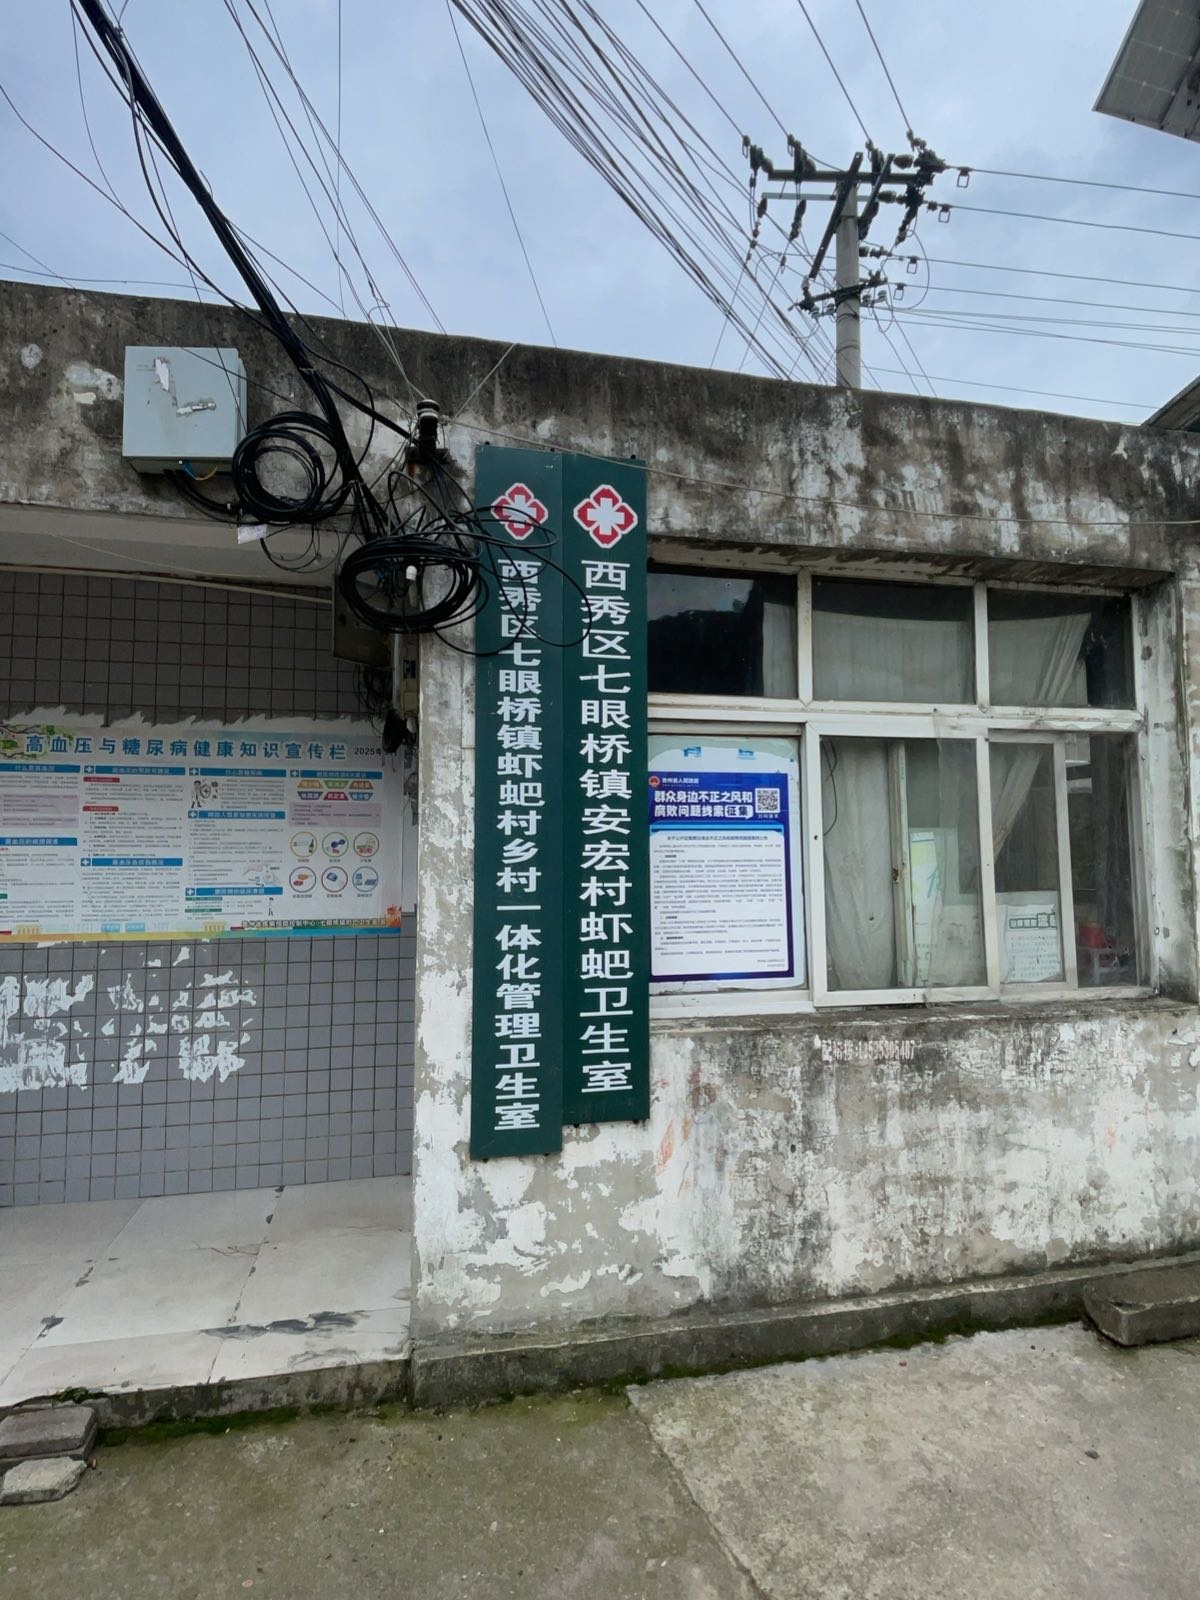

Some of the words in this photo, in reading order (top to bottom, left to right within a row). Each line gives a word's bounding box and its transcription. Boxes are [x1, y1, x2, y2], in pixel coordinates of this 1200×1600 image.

[26, 735, 346, 761] 高血压与糖尿病健康知识宣传栏
[654, 790, 753, 803] 群众身边不正之风和
[654, 805, 748, 818] 腐败问题线索征集
[579, 560, 634, 1093] 西秀区七眼桥镇安宏村虾蚆卫生室
[496, 559, 543, 1131] 西秀区七眼桥镇虾蚆村乡村一体化管理卫生室
